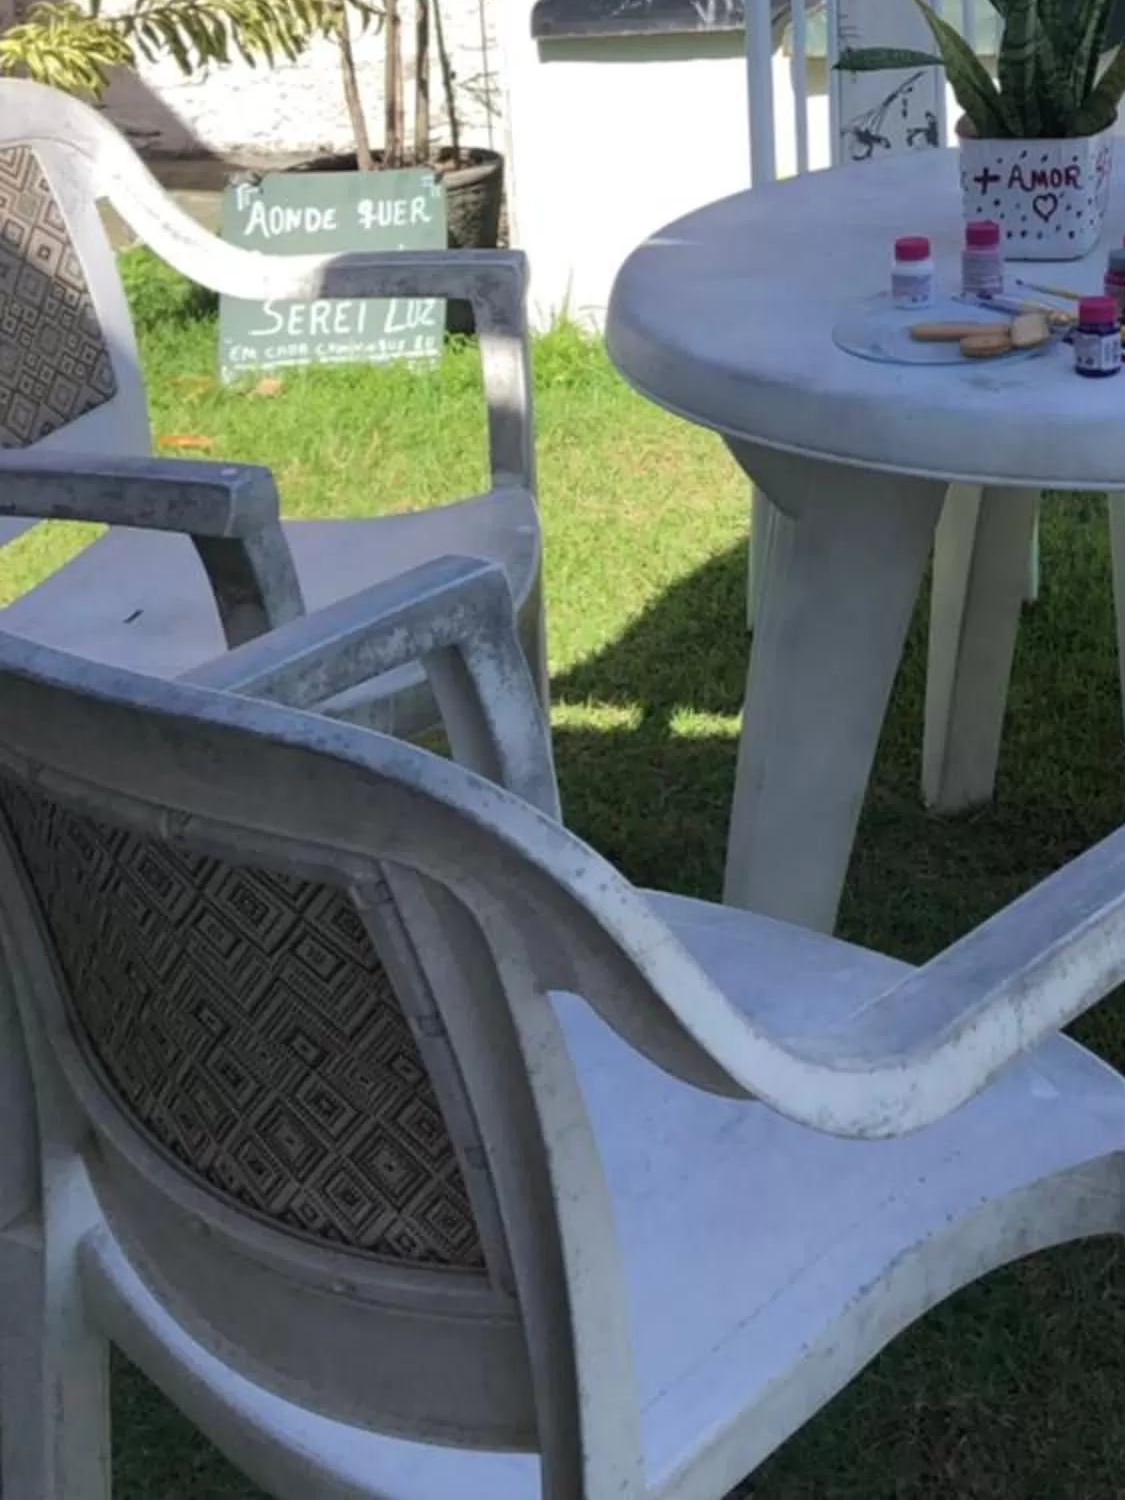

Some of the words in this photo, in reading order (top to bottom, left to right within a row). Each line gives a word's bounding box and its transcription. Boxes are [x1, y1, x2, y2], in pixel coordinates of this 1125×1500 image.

[1008, 164, 1083, 192] AMOR
[244, 199, 337, 239] AONDE
[249, 298, 367, 336] SEREI
[384, 299, 436, 333] LUZ
